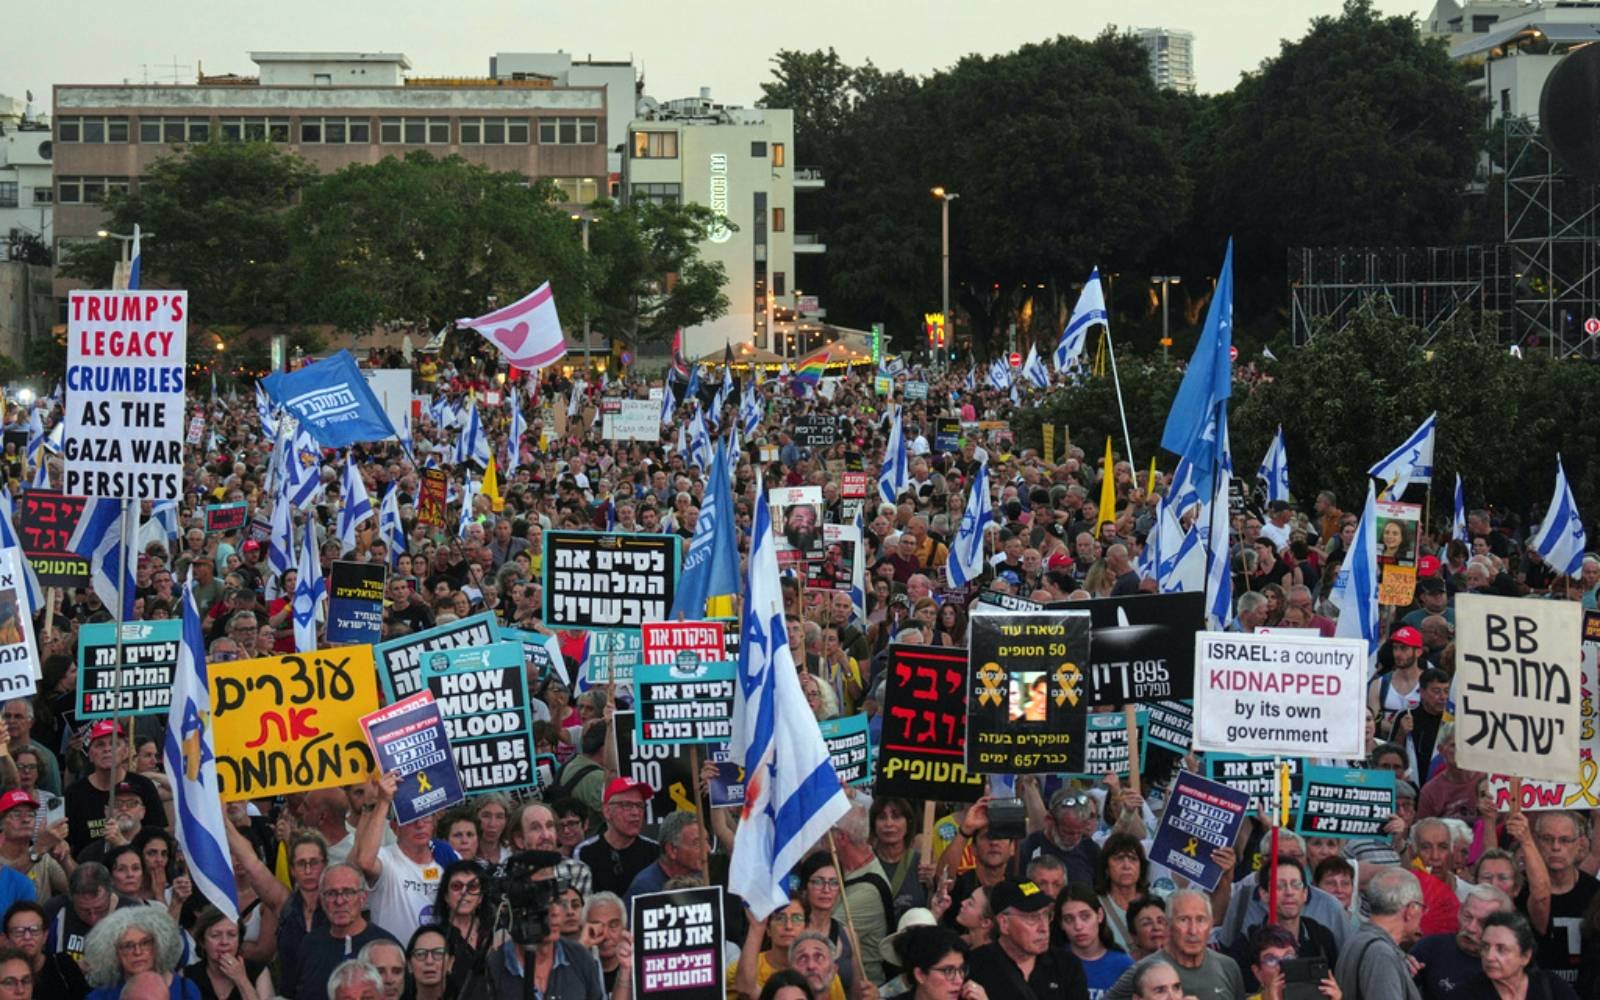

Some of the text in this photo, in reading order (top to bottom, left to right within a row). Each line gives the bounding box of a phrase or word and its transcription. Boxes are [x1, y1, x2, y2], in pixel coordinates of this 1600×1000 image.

[71, 296, 184, 322] TRUMP'S
[81, 331, 174, 357] LEGACY
[67, 366, 184, 394] CRUMBLES
[81, 401, 166, 428] AS THE
[65, 438, 182, 465] GAZA WAR
[66, 471, 178, 500] PERSISTS
[24, 527, 70, 549] וגד
[555, 549, 665, 572] לסיים את
[555, 571, 665, 595] המלחמה
[554, 594, 665, 624] עכשיו!
[649, 628, 718, 646] הפקרת את
[1000, 624, 1066, 636] נשארו עוד
[1486, 614, 1538, 654] BB
[126, 642, 176, 664] לסיים
[998, 644, 1067, 656] 50 חטופים
[1208, 643, 1354, 670] ISRAEL: a country
[440, 669, 505, 695] HOW
[895, 661, 967, 704] יבי
[1092, 661, 1130, 701] די!
[1133, 659, 1170, 683] 895
[1209, 669, 1342, 696] KIDNAPPED
[1464, 654, 1571, 705] מחריב
[214, 656, 355, 717] עוצרים
[652, 681, 733, 700] לסיים את
[1135, 682, 1171, 698] נופלים
[137, 687, 174, 711] מען
[437, 690, 514, 717] MUCH
[654, 702, 728, 719] המלחמה
[1235, 699, 1321, 719] by its own
[245, 707, 320, 748] את
[445, 712, 521, 739] BLOOD
[644, 718, 733, 740] מען כולנו!
[1163, 713, 1193, 733] HOSTA
[1226, 725, 1329, 743] government
[1462, 695, 1565, 755] ישראל
[827, 733, 866, 752] הממשל
[979, 733, 1070, 747] מופקרים בעזה
[1150, 724, 1192, 748] HAVEN'
[215, 732, 376, 793] המלחמה
[401, 750, 445, 774] החטופי
[496, 738, 526, 764] BE
[980, 753, 1068, 767] כבר 657 ימים
[462, 760, 529, 789] ILLED?
[1223, 758, 1297, 776] ליים את
[1344, 788, 1392, 802] הממשלה
[1496, 784, 1566, 809] NOW
[1307, 800, 1371, 818] החטופים
[1312, 815, 1381, 833] אנחנו לא!
[642, 902, 713, 930] מצילים
[643, 924, 714, 950] את עזה
[646, 953, 712, 972] מצילים את
[646, 967, 712, 990] החטופים
